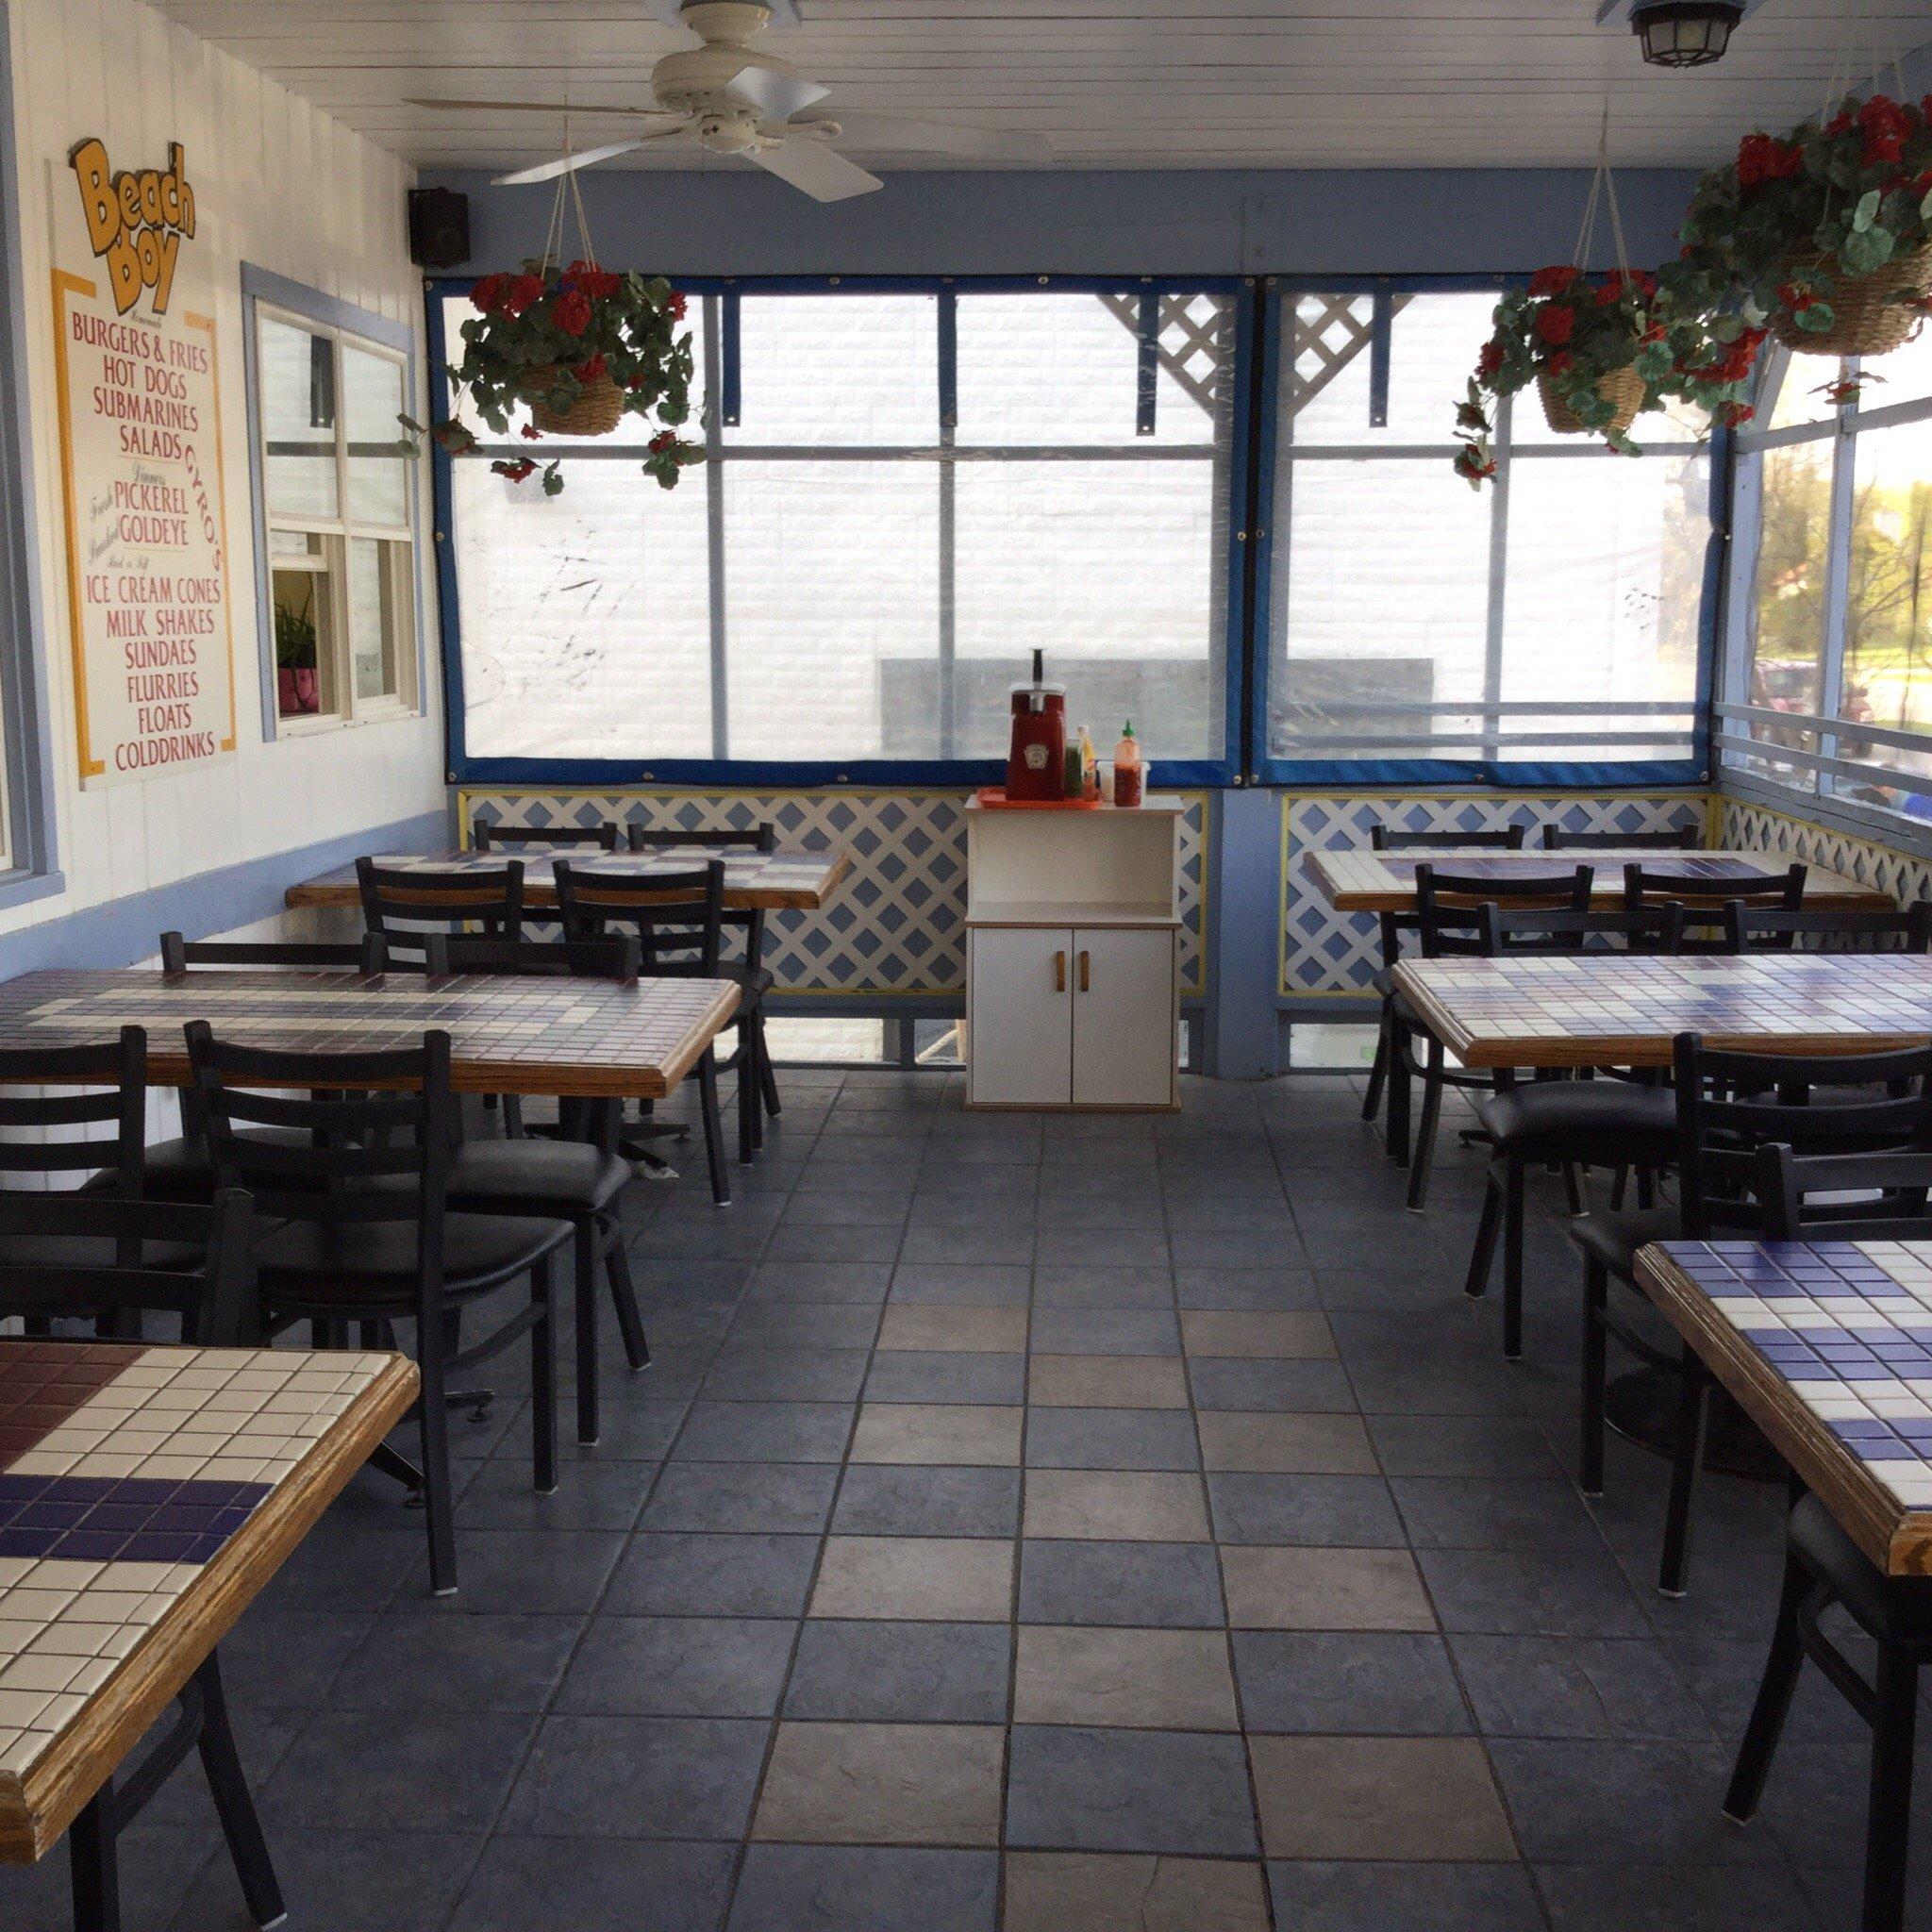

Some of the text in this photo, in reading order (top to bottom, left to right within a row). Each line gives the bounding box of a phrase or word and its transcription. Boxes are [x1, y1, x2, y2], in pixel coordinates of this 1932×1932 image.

[67, 137, 196, 258] Beach
[72, 311, 208, 374] BURGERS & FRIES
[103, 355, 187, 400] HOT DOGS
[93, 386, 199, 432] SUBMARINES
[120, 425, 182, 459] SALADS
[114, 480, 189, 514] PICKEREL
[120, 514, 189, 545] GOLDEYE
[86, 575, 221, 605] ICE CREAM CONES
[107, 608, 215, 638] MILK SHAKES
[125, 639, 197, 670] SUNDAES
[126, 671, 199, 703] FLURRIES
[139, 703, 192, 734] FLOATS
[115, 731, 215, 772] COLDDRINKS
